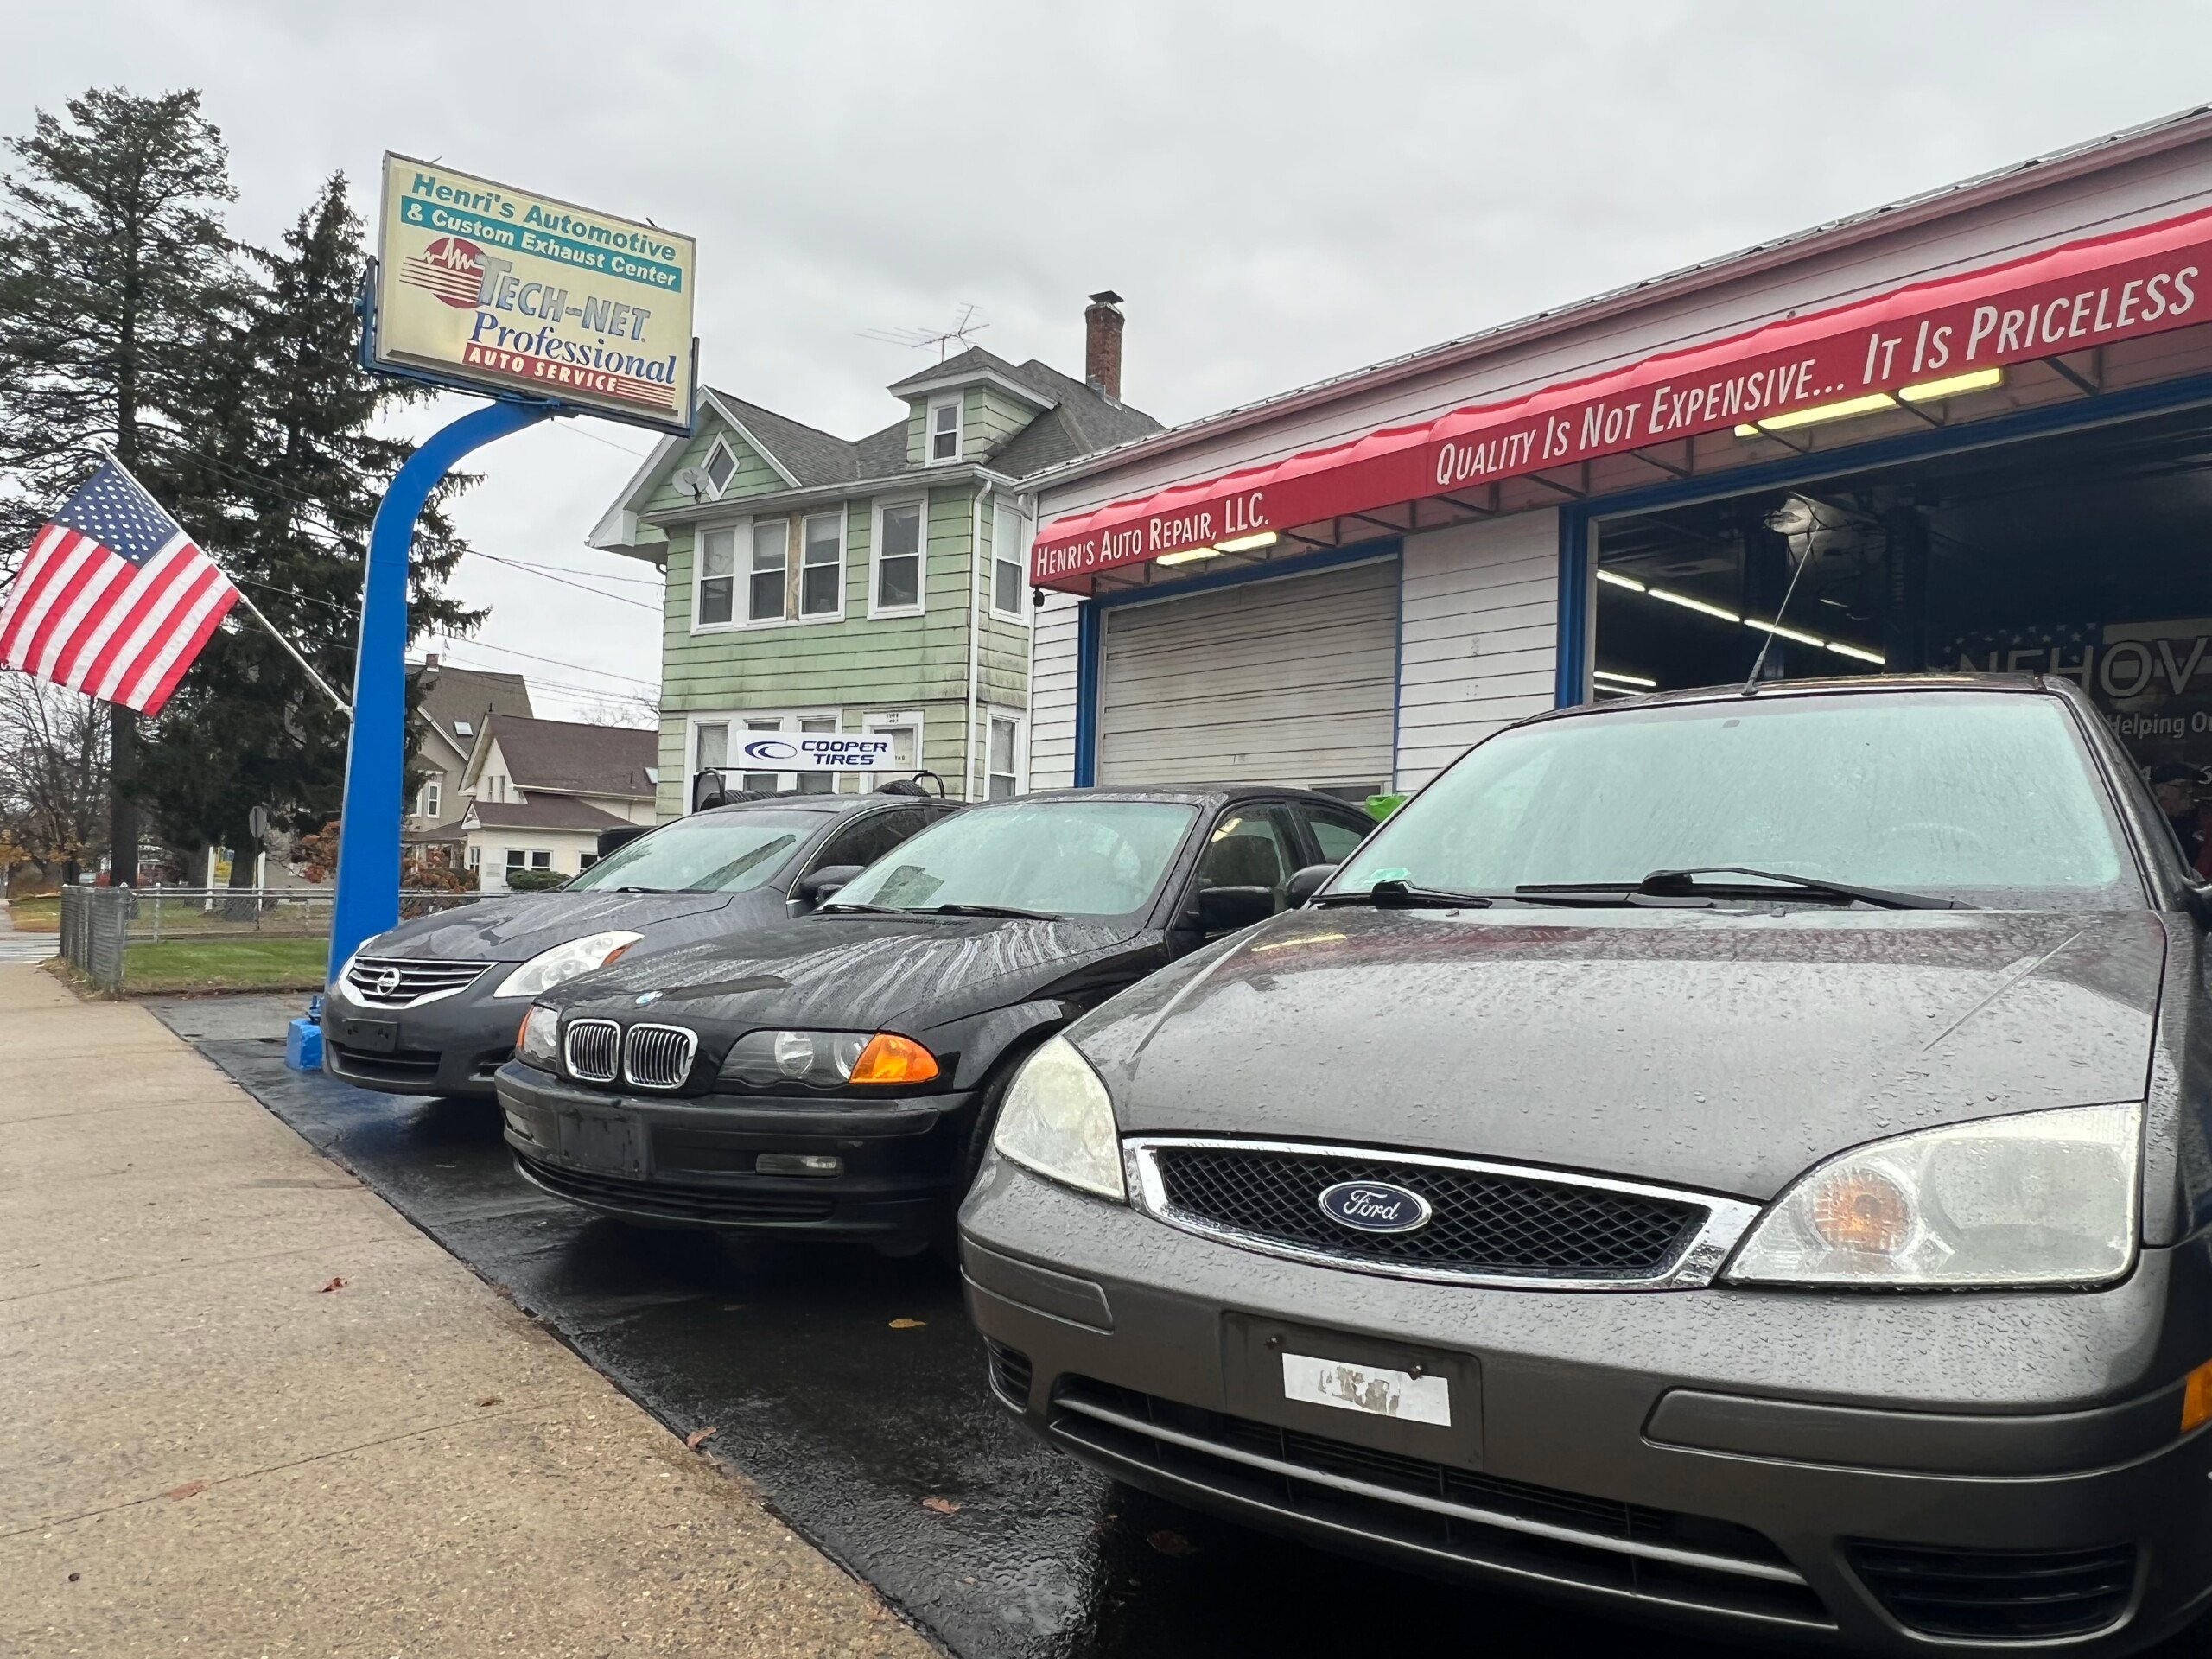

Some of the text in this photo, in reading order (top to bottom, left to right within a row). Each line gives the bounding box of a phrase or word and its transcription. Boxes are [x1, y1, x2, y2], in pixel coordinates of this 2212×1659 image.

[407, 203, 677, 286] & Custom Exhaust Center
[411, 173, 677, 261] Henri's Automotive
[474, 252, 651, 341] TECH-NET
[467, 310, 677, 385] Professional
[468, 347, 618, 393] AUTO SERVICE
[1435, 266, 2199, 486] QUALITY IS NOT EXPENSIVE... IT IS PRICELESS
[1036, 492, 1269, 577] HENRI'S AUTO REPAIR, LLC.
[801, 741, 887, 753] COOPER
[814, 753, 874, 766] TIRES
[2107, 712, 2185, 739] Helping
[1343, 1189, 1401, 1220] Ford
